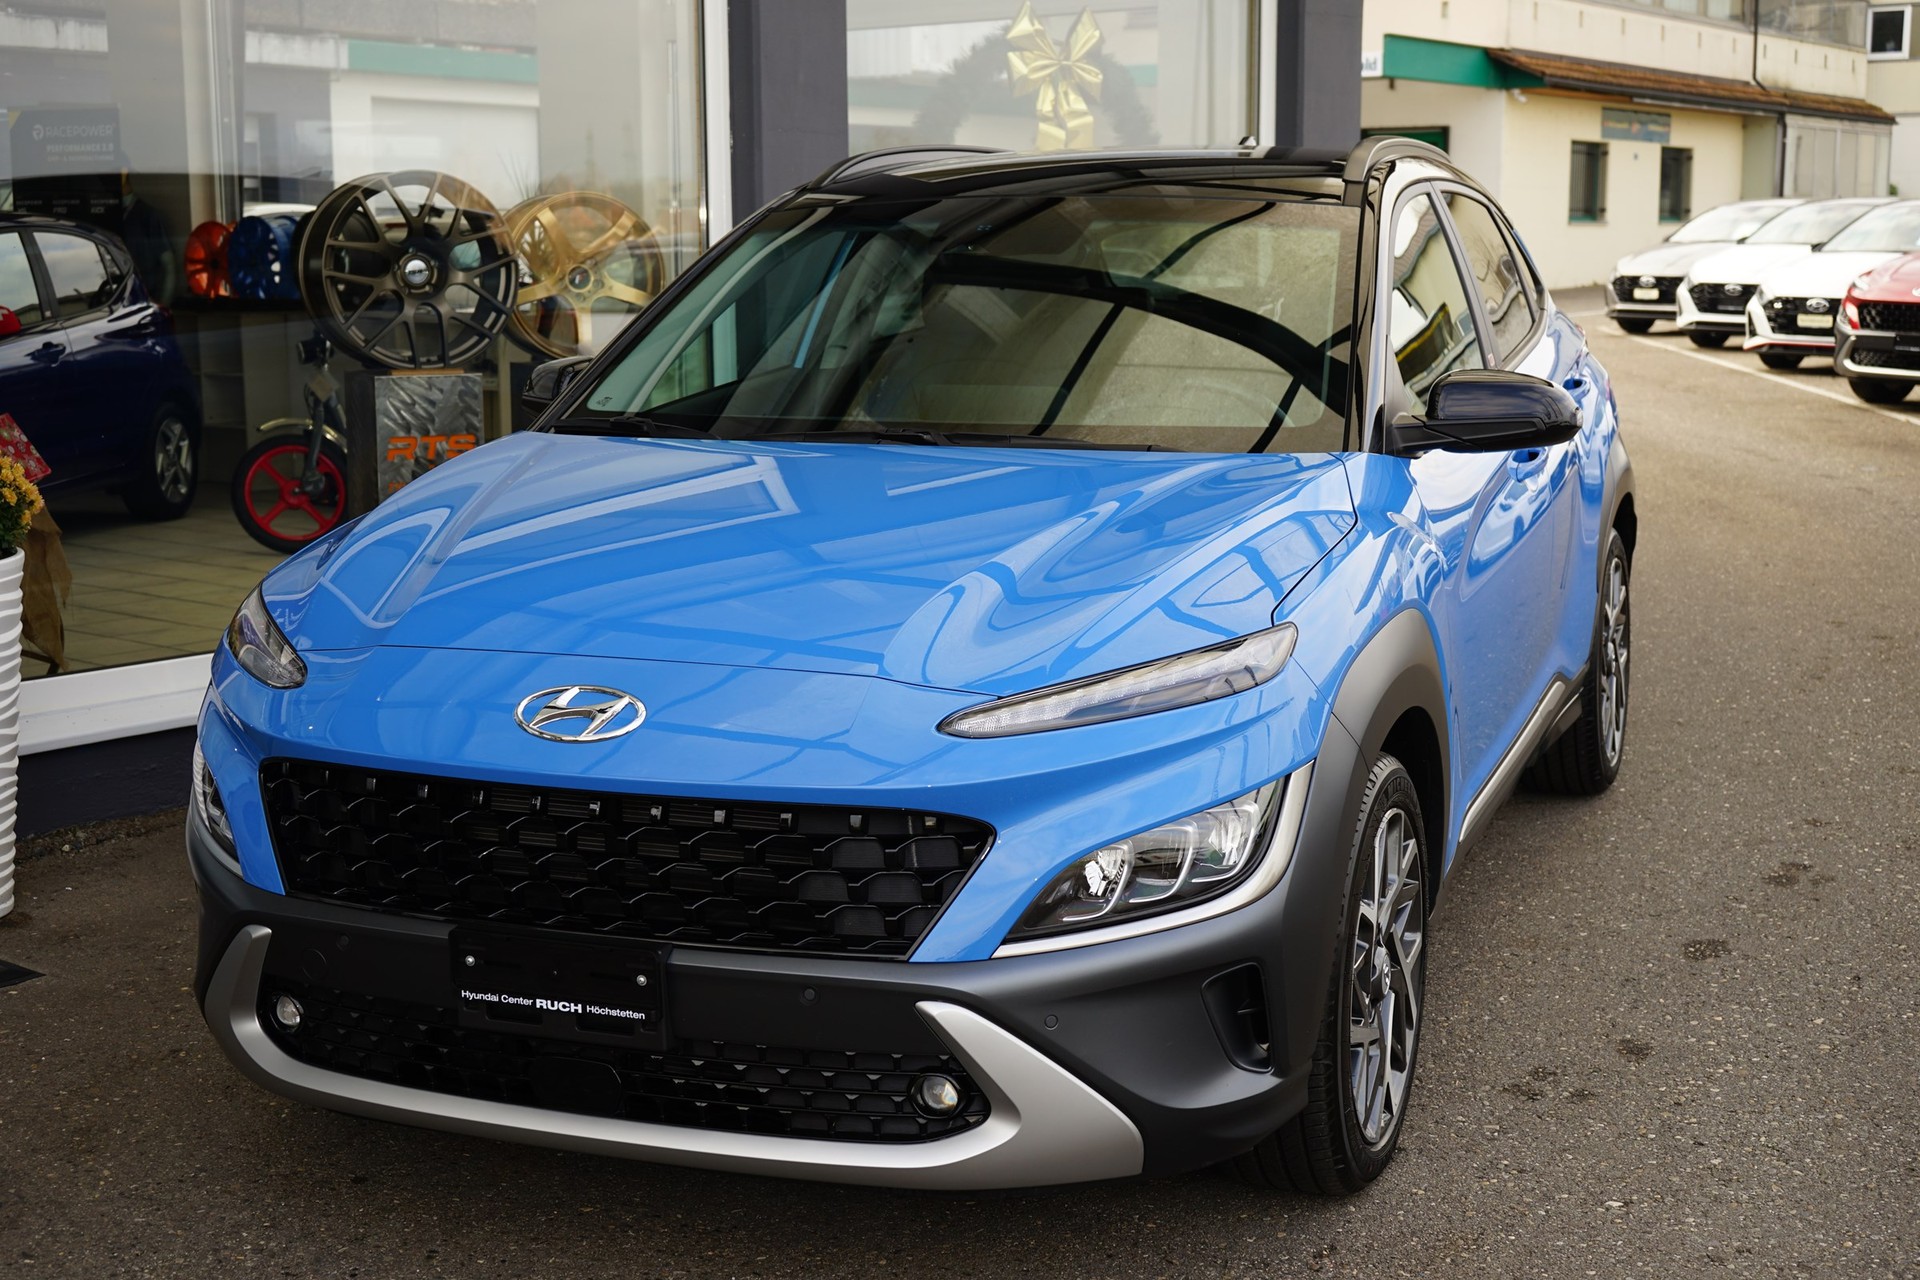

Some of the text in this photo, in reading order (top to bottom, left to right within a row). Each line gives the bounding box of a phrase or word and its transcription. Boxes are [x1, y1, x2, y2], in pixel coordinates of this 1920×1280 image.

[45, 124, 114, 138] RACEPOWER
[387, 434, 475, 461] RTS
[461, 989, 646, 1020] Hyundai Center RUCH Höchstetten
